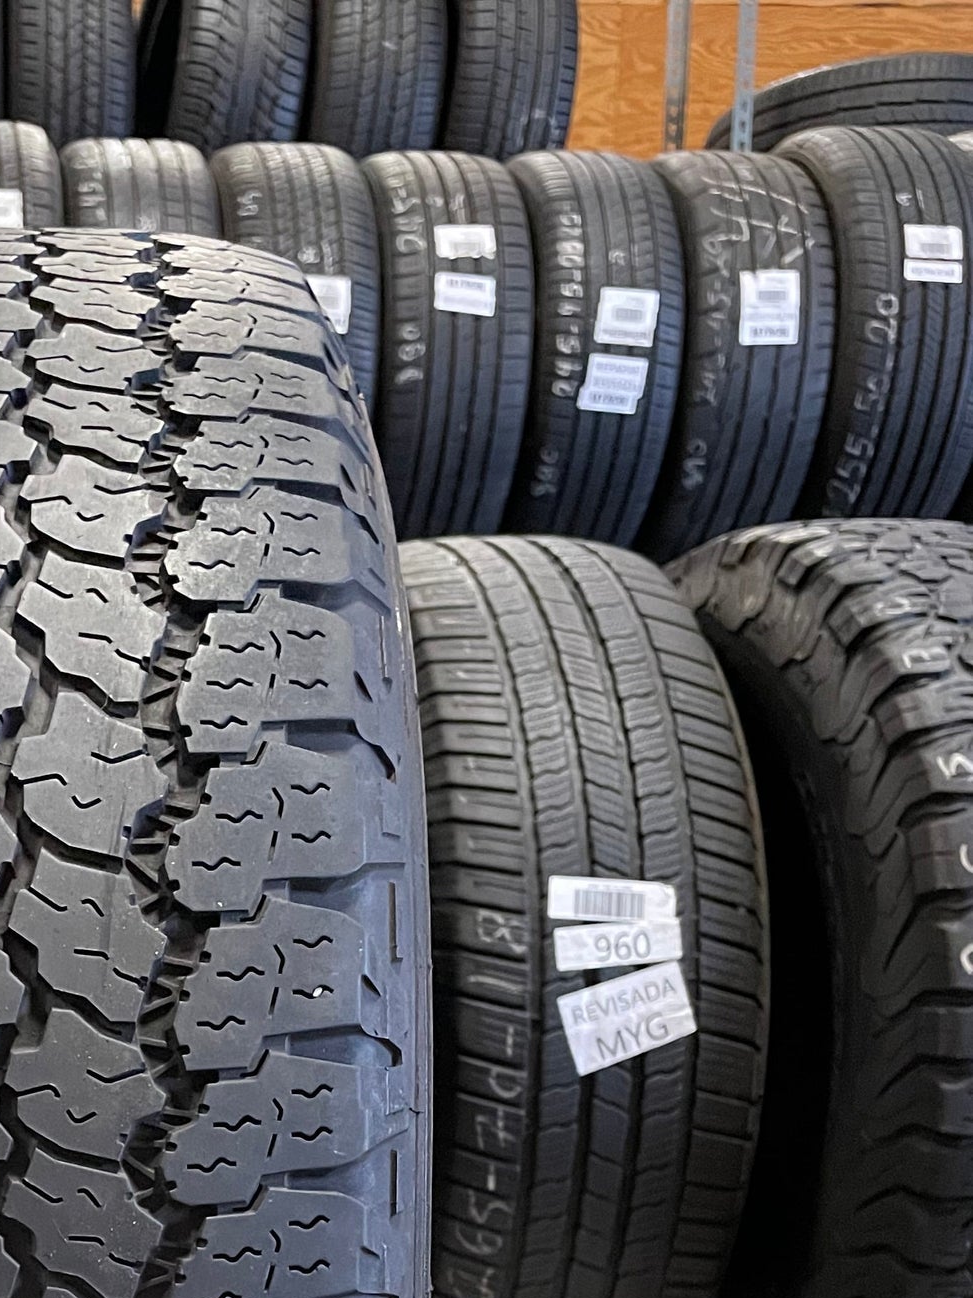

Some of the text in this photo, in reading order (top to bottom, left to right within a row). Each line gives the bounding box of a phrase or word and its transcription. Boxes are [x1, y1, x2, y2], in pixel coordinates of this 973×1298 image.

[593, 929, 652, 962] 960
[570, 978, 677, 1025] REVISADA
[595, 1011, 670, 1061] MYG
